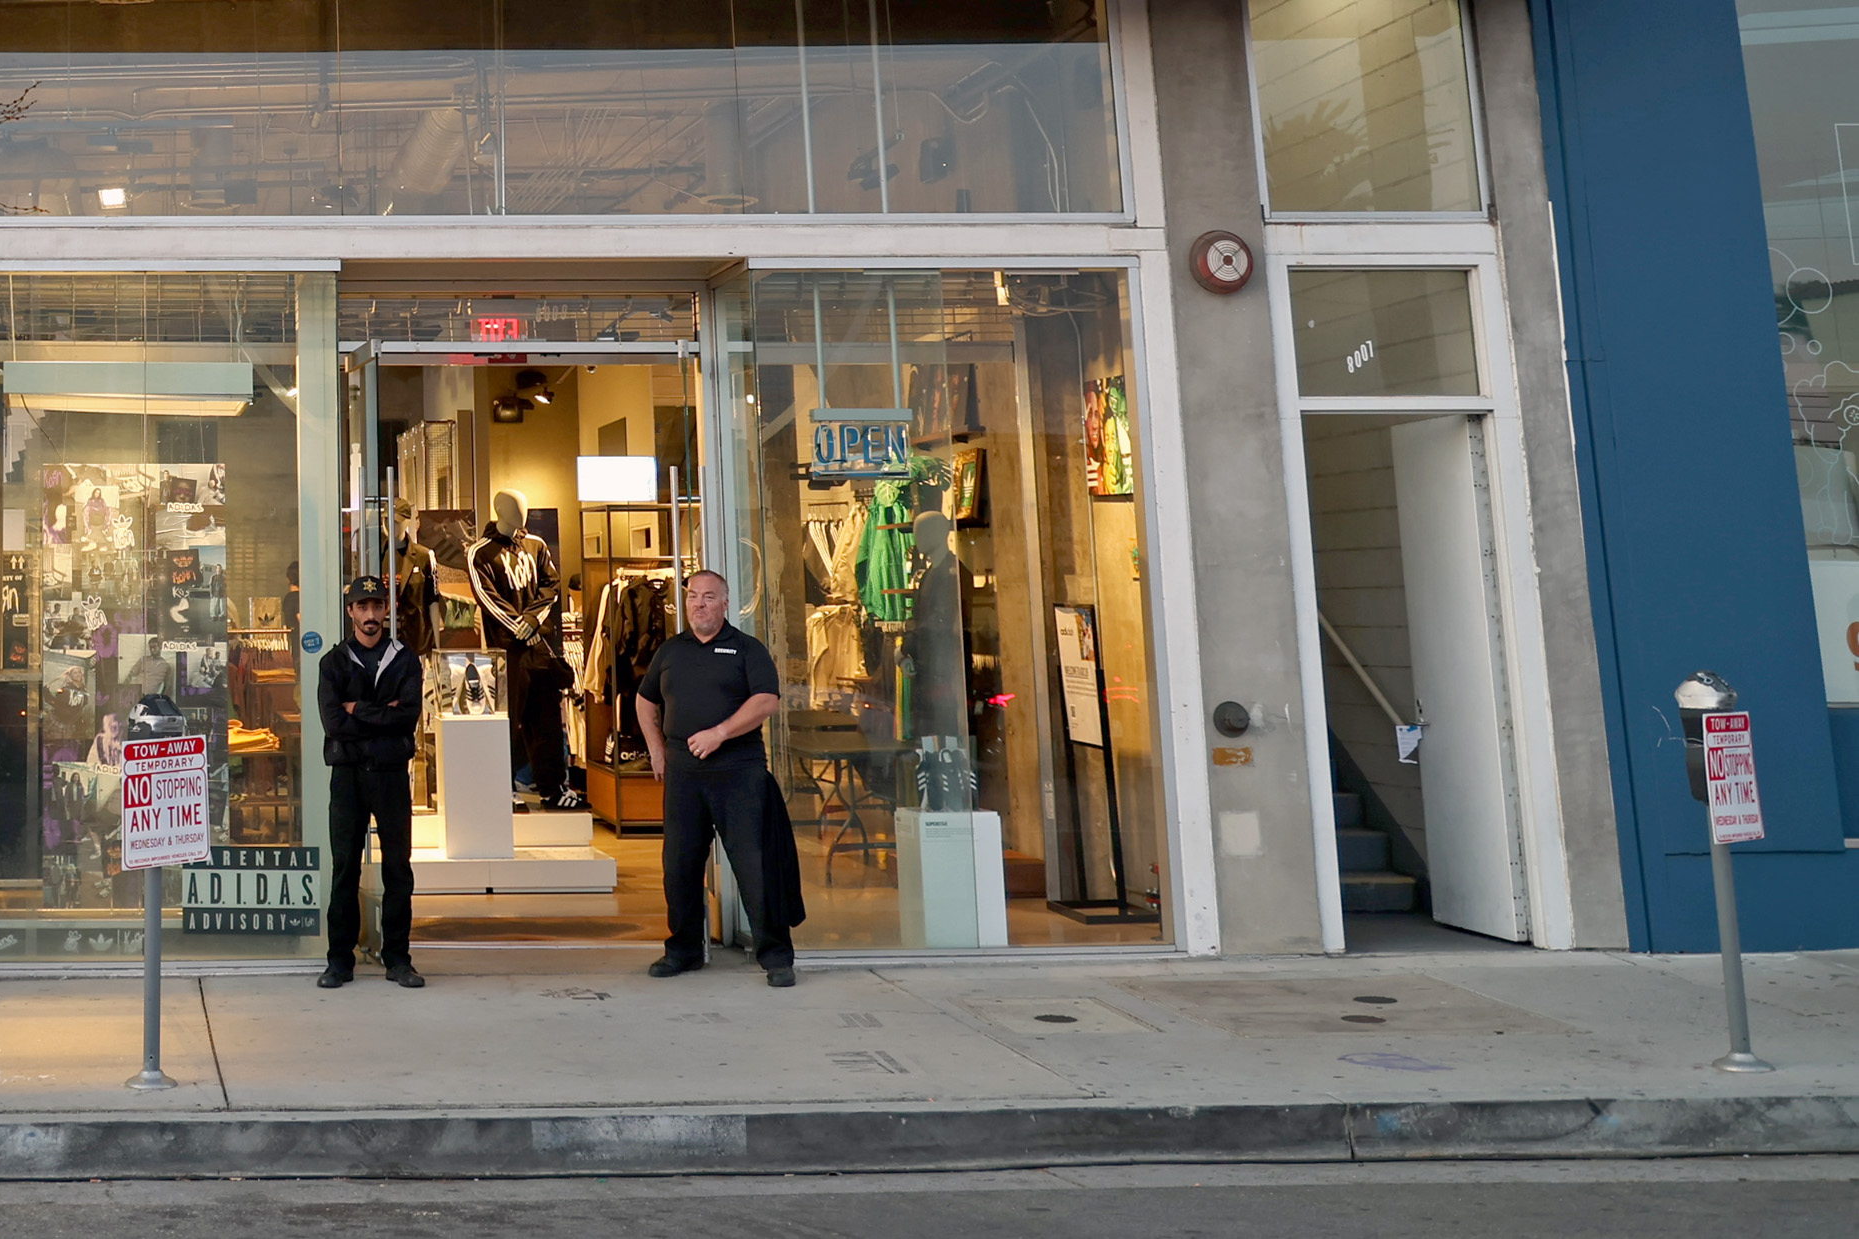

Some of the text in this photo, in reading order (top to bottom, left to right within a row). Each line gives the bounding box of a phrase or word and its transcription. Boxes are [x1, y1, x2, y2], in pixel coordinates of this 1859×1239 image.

[1346, 340, 1374, 374] 8007
[815, 424, 907, 464] OPEN
[714, 647, 737, 655] SECURITY
[1710, 717, 1745, 731] TOW-AWAY
[1713, 734, 1745, 745] TEMPORARY
[133, 740, 196, 758] TOW-AWAY
[620, 750, 651, 760] adid
[135, 757, 195, 772] TEMPORARY
[1709, 749, 1753, 779] NO STOPPING
[127, 775, 202, 806] NO STOPPING
[1715, 781, 1756, 806] ANY TIME
[130, 803, 202, 833] ANY TIME
[130, 833, 204, 851] WEDNESDAY & THURSDAY
[189, 850, 313, 867] RENTAL
[187, 872, 316, 906] A.D.I.D.A.S.
[189, 912, 286, 930] ADVISORY
